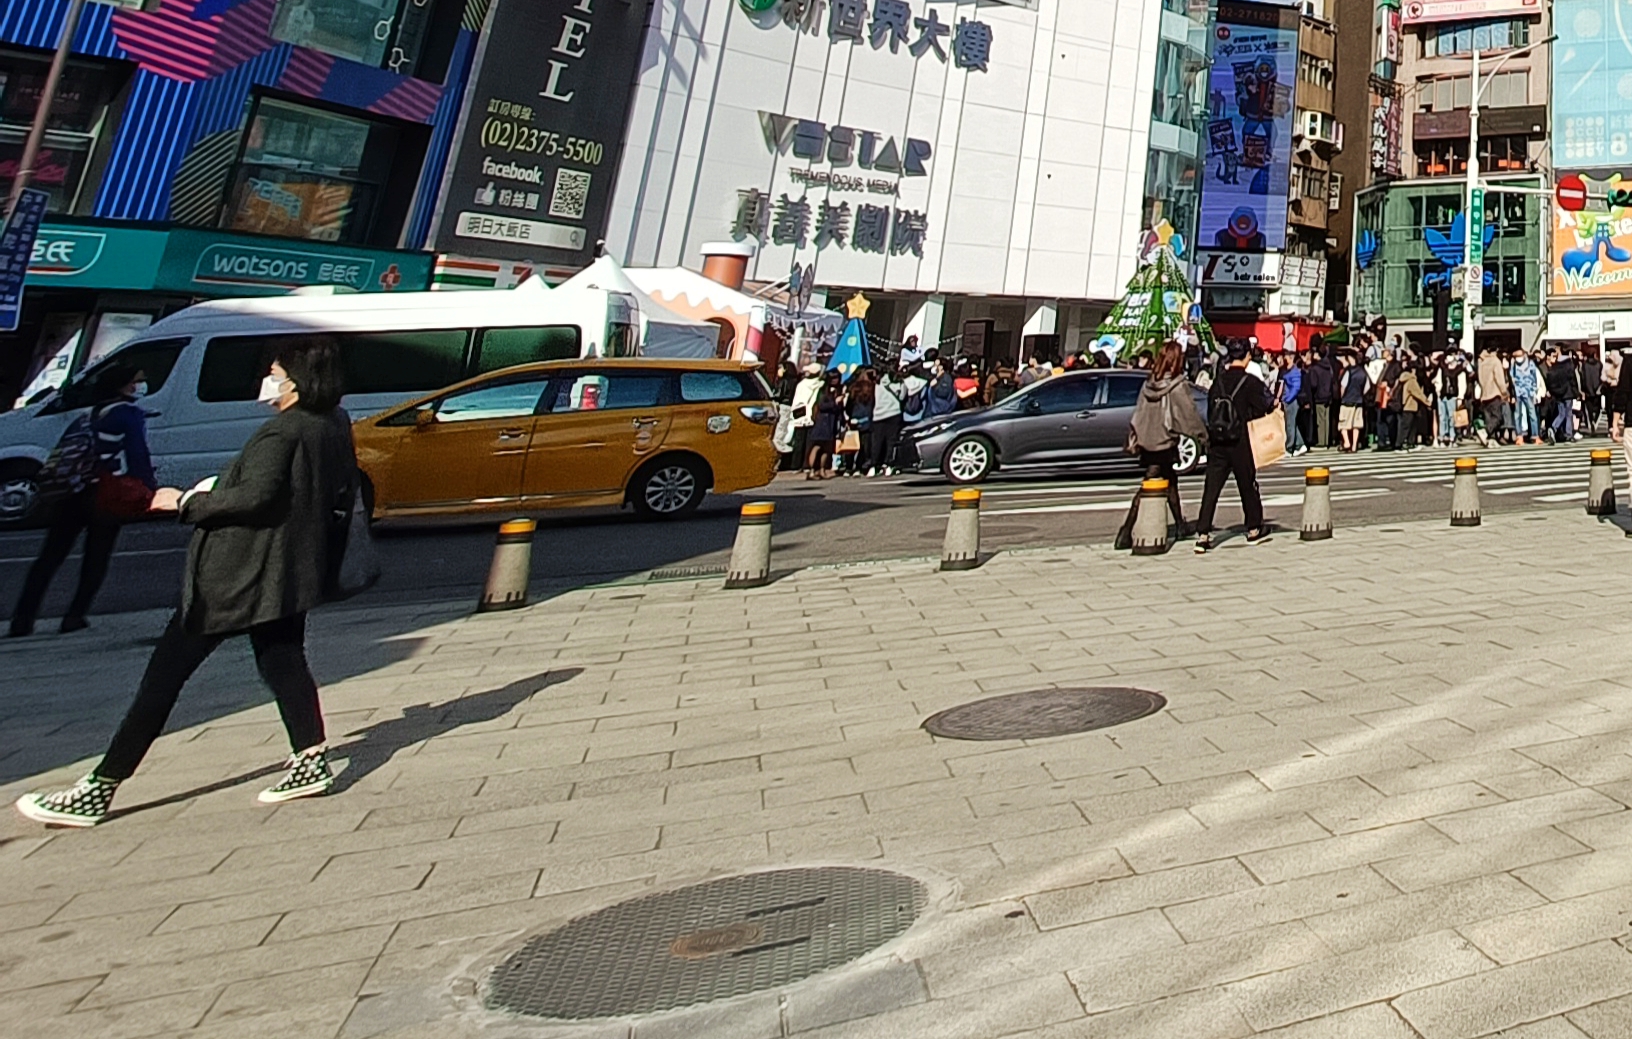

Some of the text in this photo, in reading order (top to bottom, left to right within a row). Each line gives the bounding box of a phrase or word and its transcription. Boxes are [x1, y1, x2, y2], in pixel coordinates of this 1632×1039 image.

[480, 116, 603, 165] (02)2375-5500
[498, 188, 540, 210] 粉絲團
[467, 216, 531, 240] 明日大飯店
[730, 187, 928, 259] 真善美劇院
[213, 253, 309, 278] watsons
[1424, 268, 1495, 288] ads
